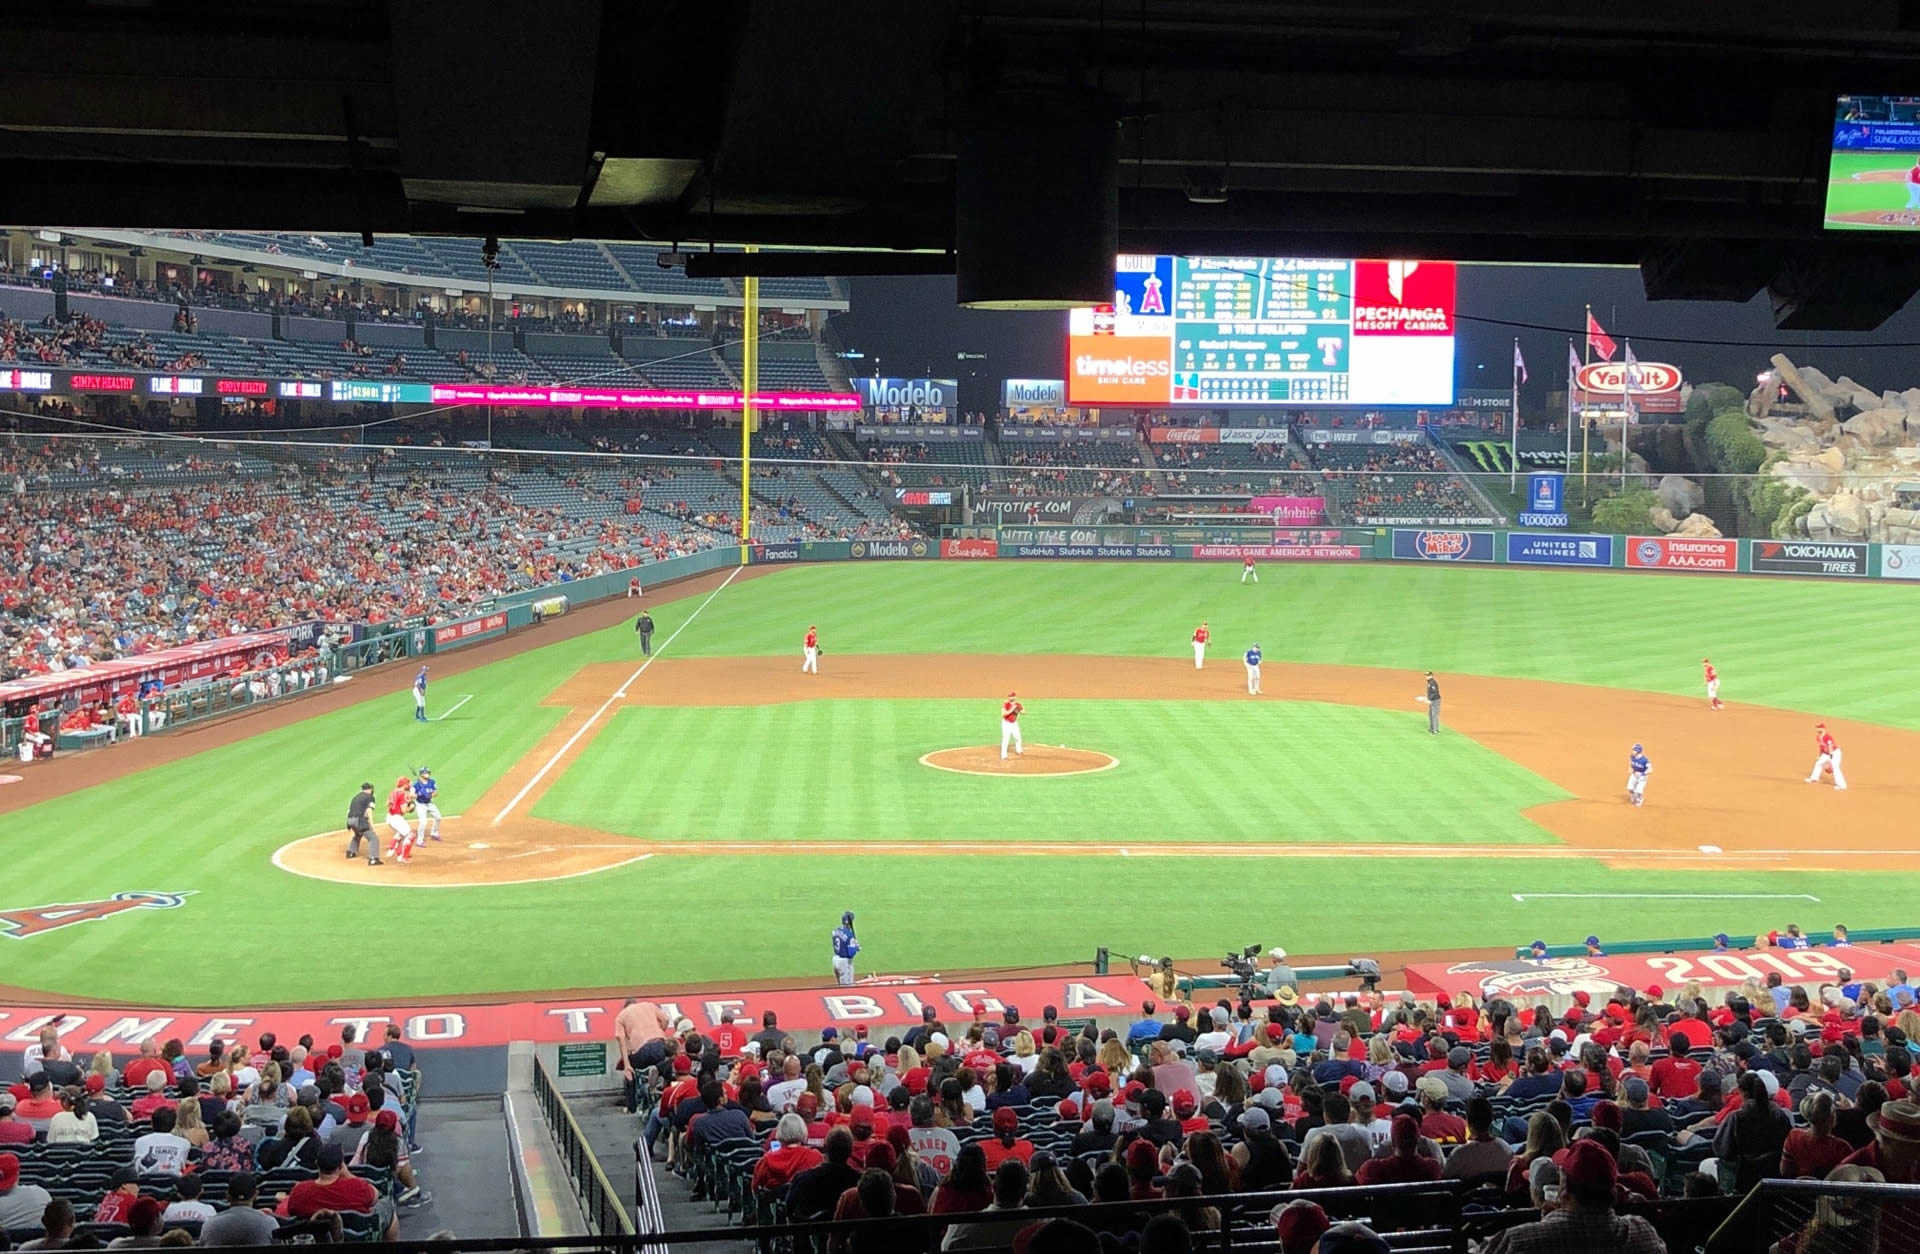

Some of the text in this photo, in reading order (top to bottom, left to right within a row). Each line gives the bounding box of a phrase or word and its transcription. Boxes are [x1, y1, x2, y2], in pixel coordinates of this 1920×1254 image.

[1355, 307, 1446, 321] PECHANGA
[1355, 321, 1399, 330] RESORT
[1076, 355, 1169, 376] timeless
[1097, 377, 1146, 385] SKIN CARE
[869, 379, 943, 406] Modelo
[1014, 384, 1057, 401] Modelo
[1482, 398, 1511, 407] STORE
[1333, 432, 1358, 441] WEST
[1385, 517, 1423, 525] NETWORK
[1456, 517, 1494, 526] NETWORK
[1424, 531, 1463, 544] Jersey
[870, 542, 908, 557] Modelo
[1533, 541, 1577, 549] UNITED
[1668, 541, 1726, 553] Insurance
[765, 550, 798, 561] Fanatics
[1019, 547, 1172, 557] StubHub StubHub StubHub StubHub
[1199, 547, 1241, 556] AMERICA'S
[1270, 547, 1311, 556] AMERICA'S
[1522, 549, 1577, 557] AIRLINES
[1783, 546, 1857, 559] YOKOHAMA
[1668, 556, 1726, 568] AAA.com
[1822, 562, 1857, 573] TIRES
[1645, 951, 1857, 985] 2019
[1063, 983, 1130, 1009] A
[330, 1013, 469, 1045] TO
[719, 1032, 733, 1050] 5
[911, 1138, 947, 1153] CAREW
